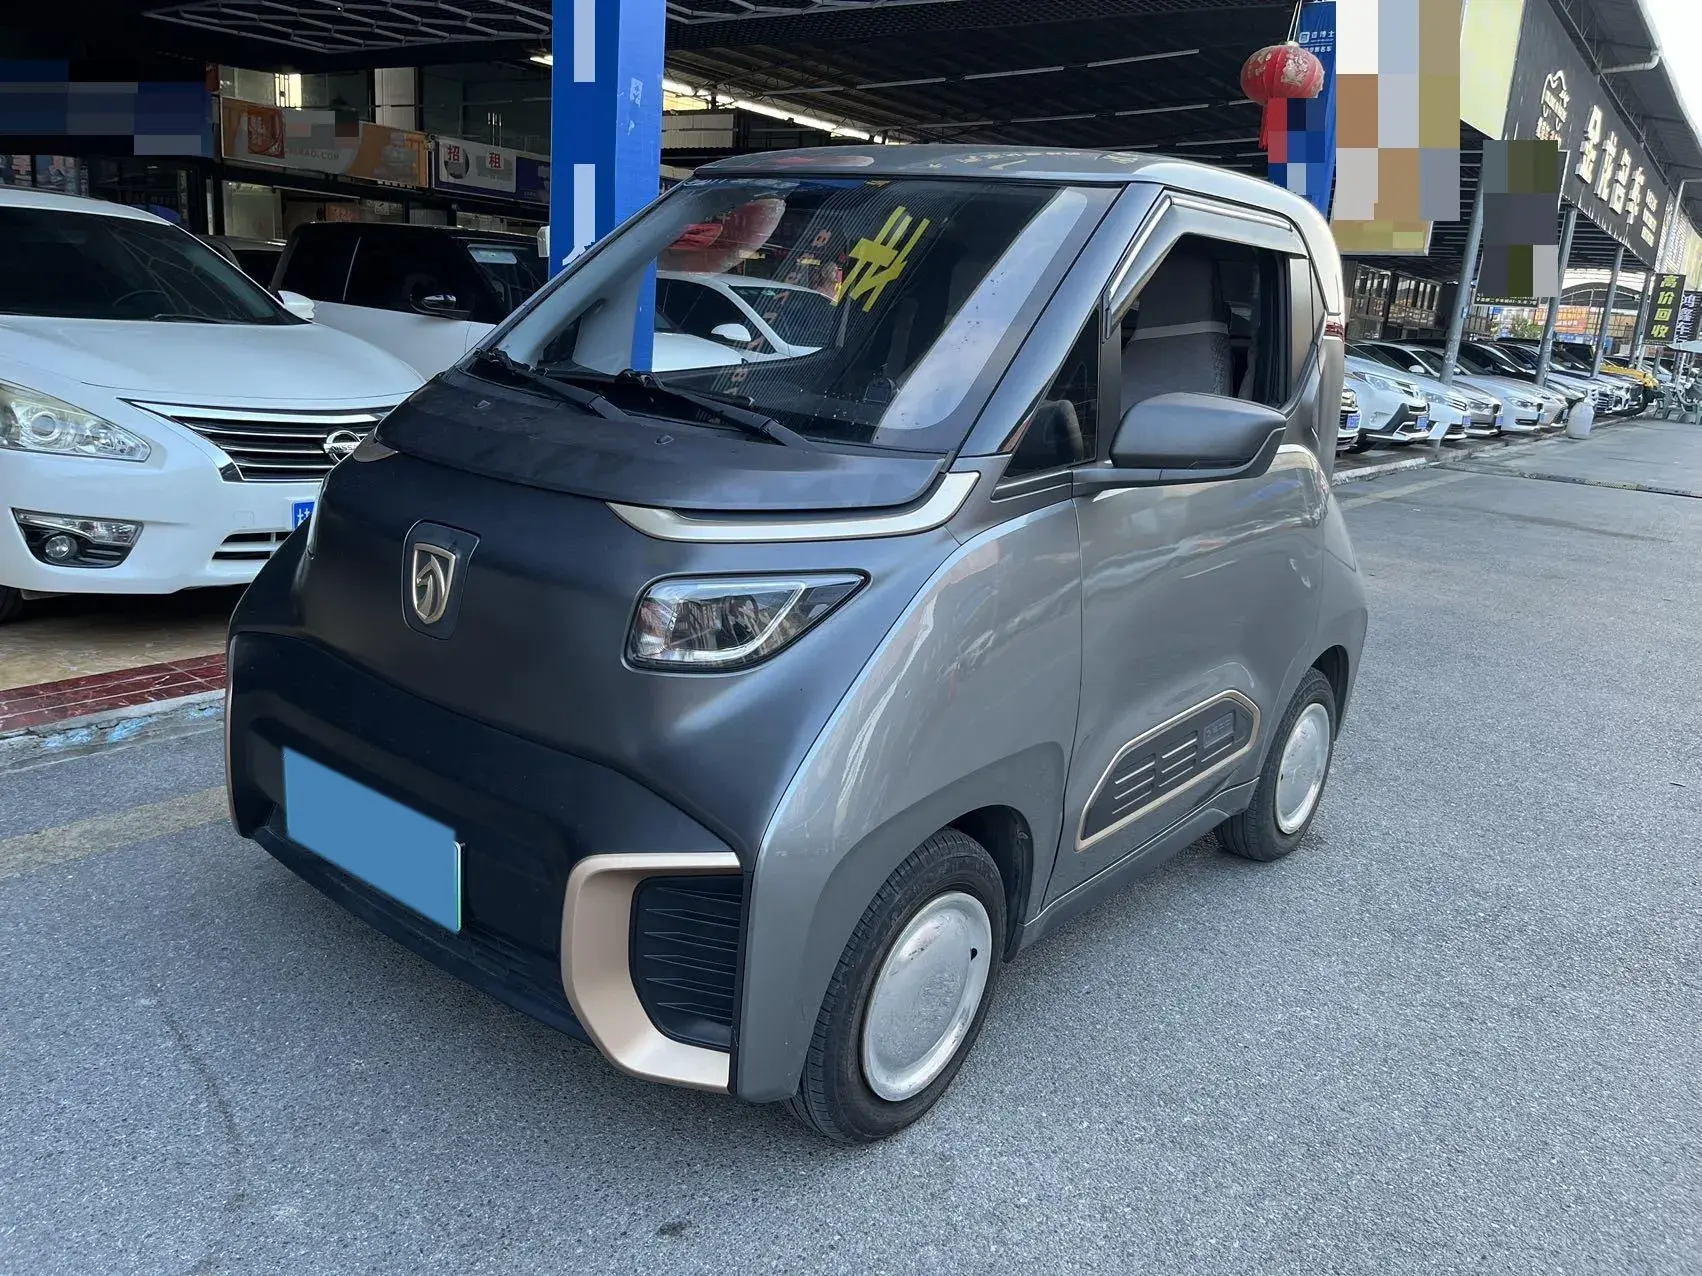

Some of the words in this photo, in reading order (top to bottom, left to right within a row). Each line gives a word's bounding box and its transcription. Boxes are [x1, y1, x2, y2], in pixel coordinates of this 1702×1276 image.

[447, 144, 460, 162] 招
[488, 151, 502, 169] 租
[1650, 274, 1680, 338] 高价回收
